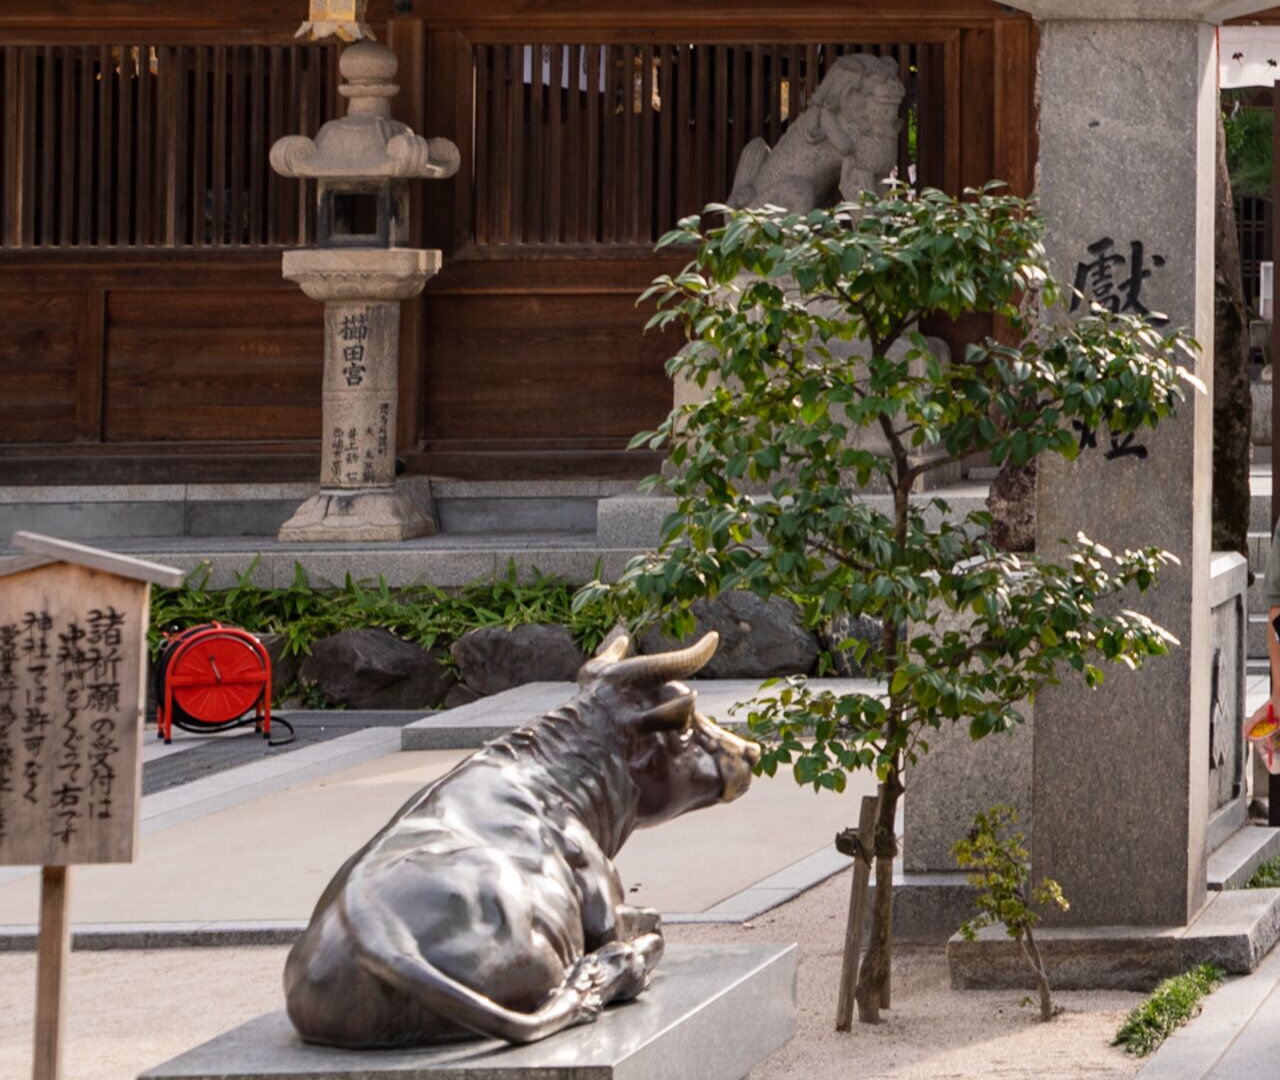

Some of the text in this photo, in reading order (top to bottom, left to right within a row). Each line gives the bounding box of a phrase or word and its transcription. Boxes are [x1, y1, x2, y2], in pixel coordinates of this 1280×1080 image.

[337, 316, 368, 388] 櫛田宮
[22, 611, 53, 805] 神社では許可なく
[83, 606, 126, 819] 諸祈願の受付は
